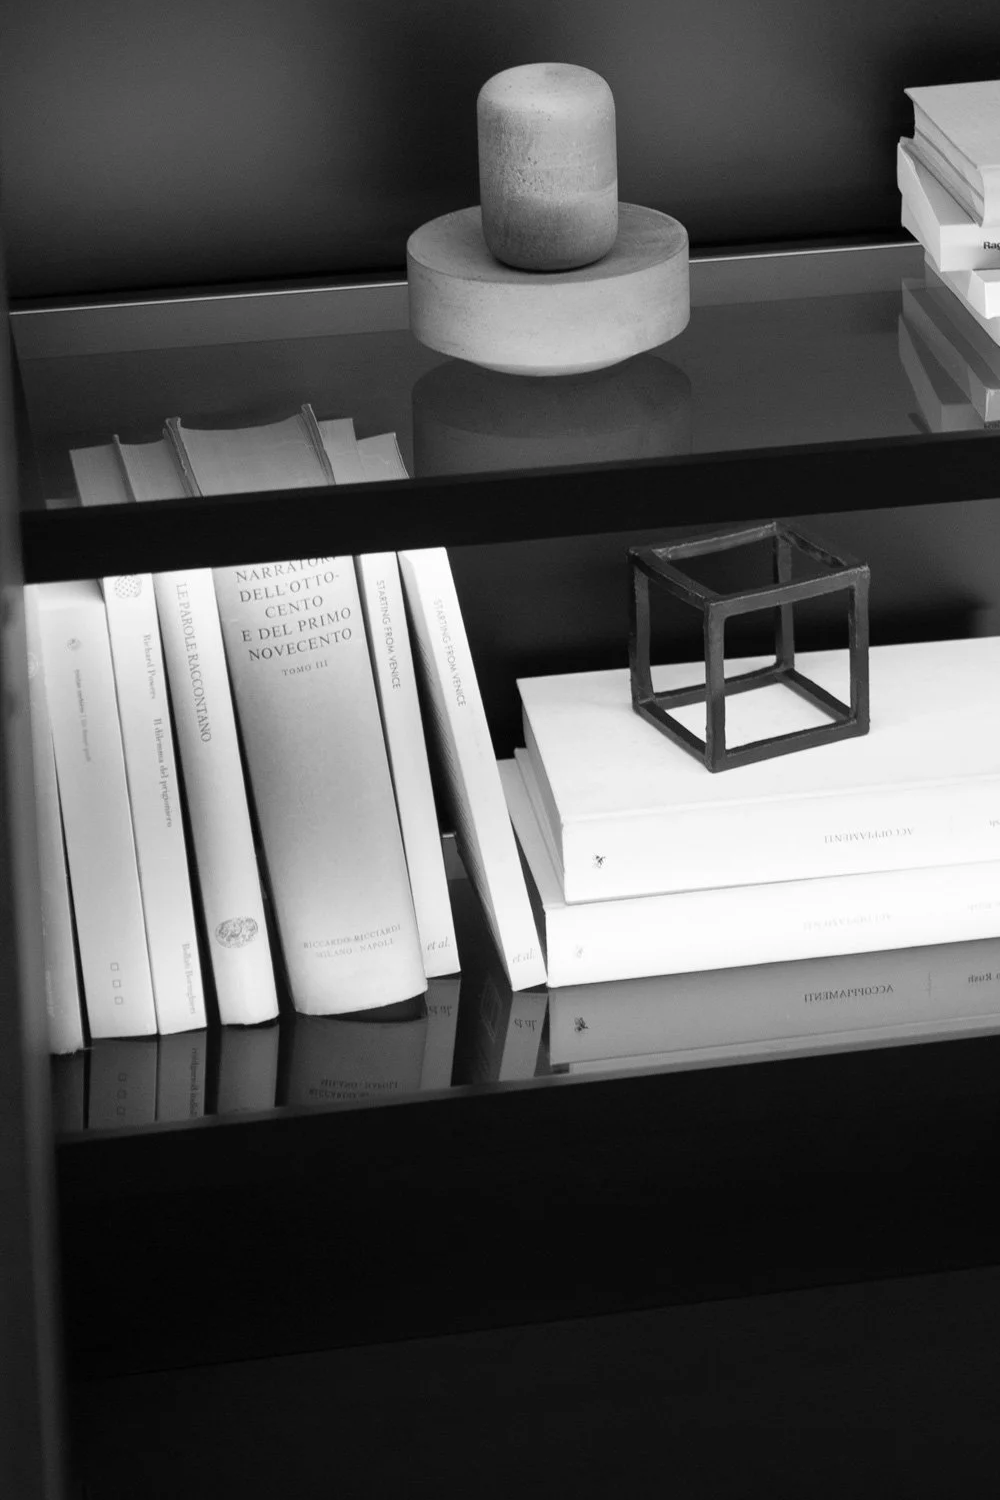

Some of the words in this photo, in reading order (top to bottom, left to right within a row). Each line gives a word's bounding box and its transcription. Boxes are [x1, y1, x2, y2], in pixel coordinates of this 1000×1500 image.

[175, 582, 188, 600] LE
[239, 570, 340, 603] DELL'OTTO-
[375, 578, 390, 625] STARTING
[264, 594, 325, 619] CENTO
[432, 597, 451, 644] STARTING
[178, 600, 197, 652] PAROLE
[240, 628, 252, 643] E
[257, 621, 294, 640] DEL
[296, 606, 353, 632] PRIMO
[382, 627, 395, 655] FROM
[247, 626, 354, 663] NOVECENTO
[443, 645, 458, 673] FROM
[280, 662, 312, 677] TOMO
[315, 659, 329, 670] III
[386, 655, 401, 690] VENICE
[186, 653, 212, 743] RACCONTANO
[449, 673, 466, 708] VENICE
[822, 825, 913, 845] ACCOPPIAMENTI
